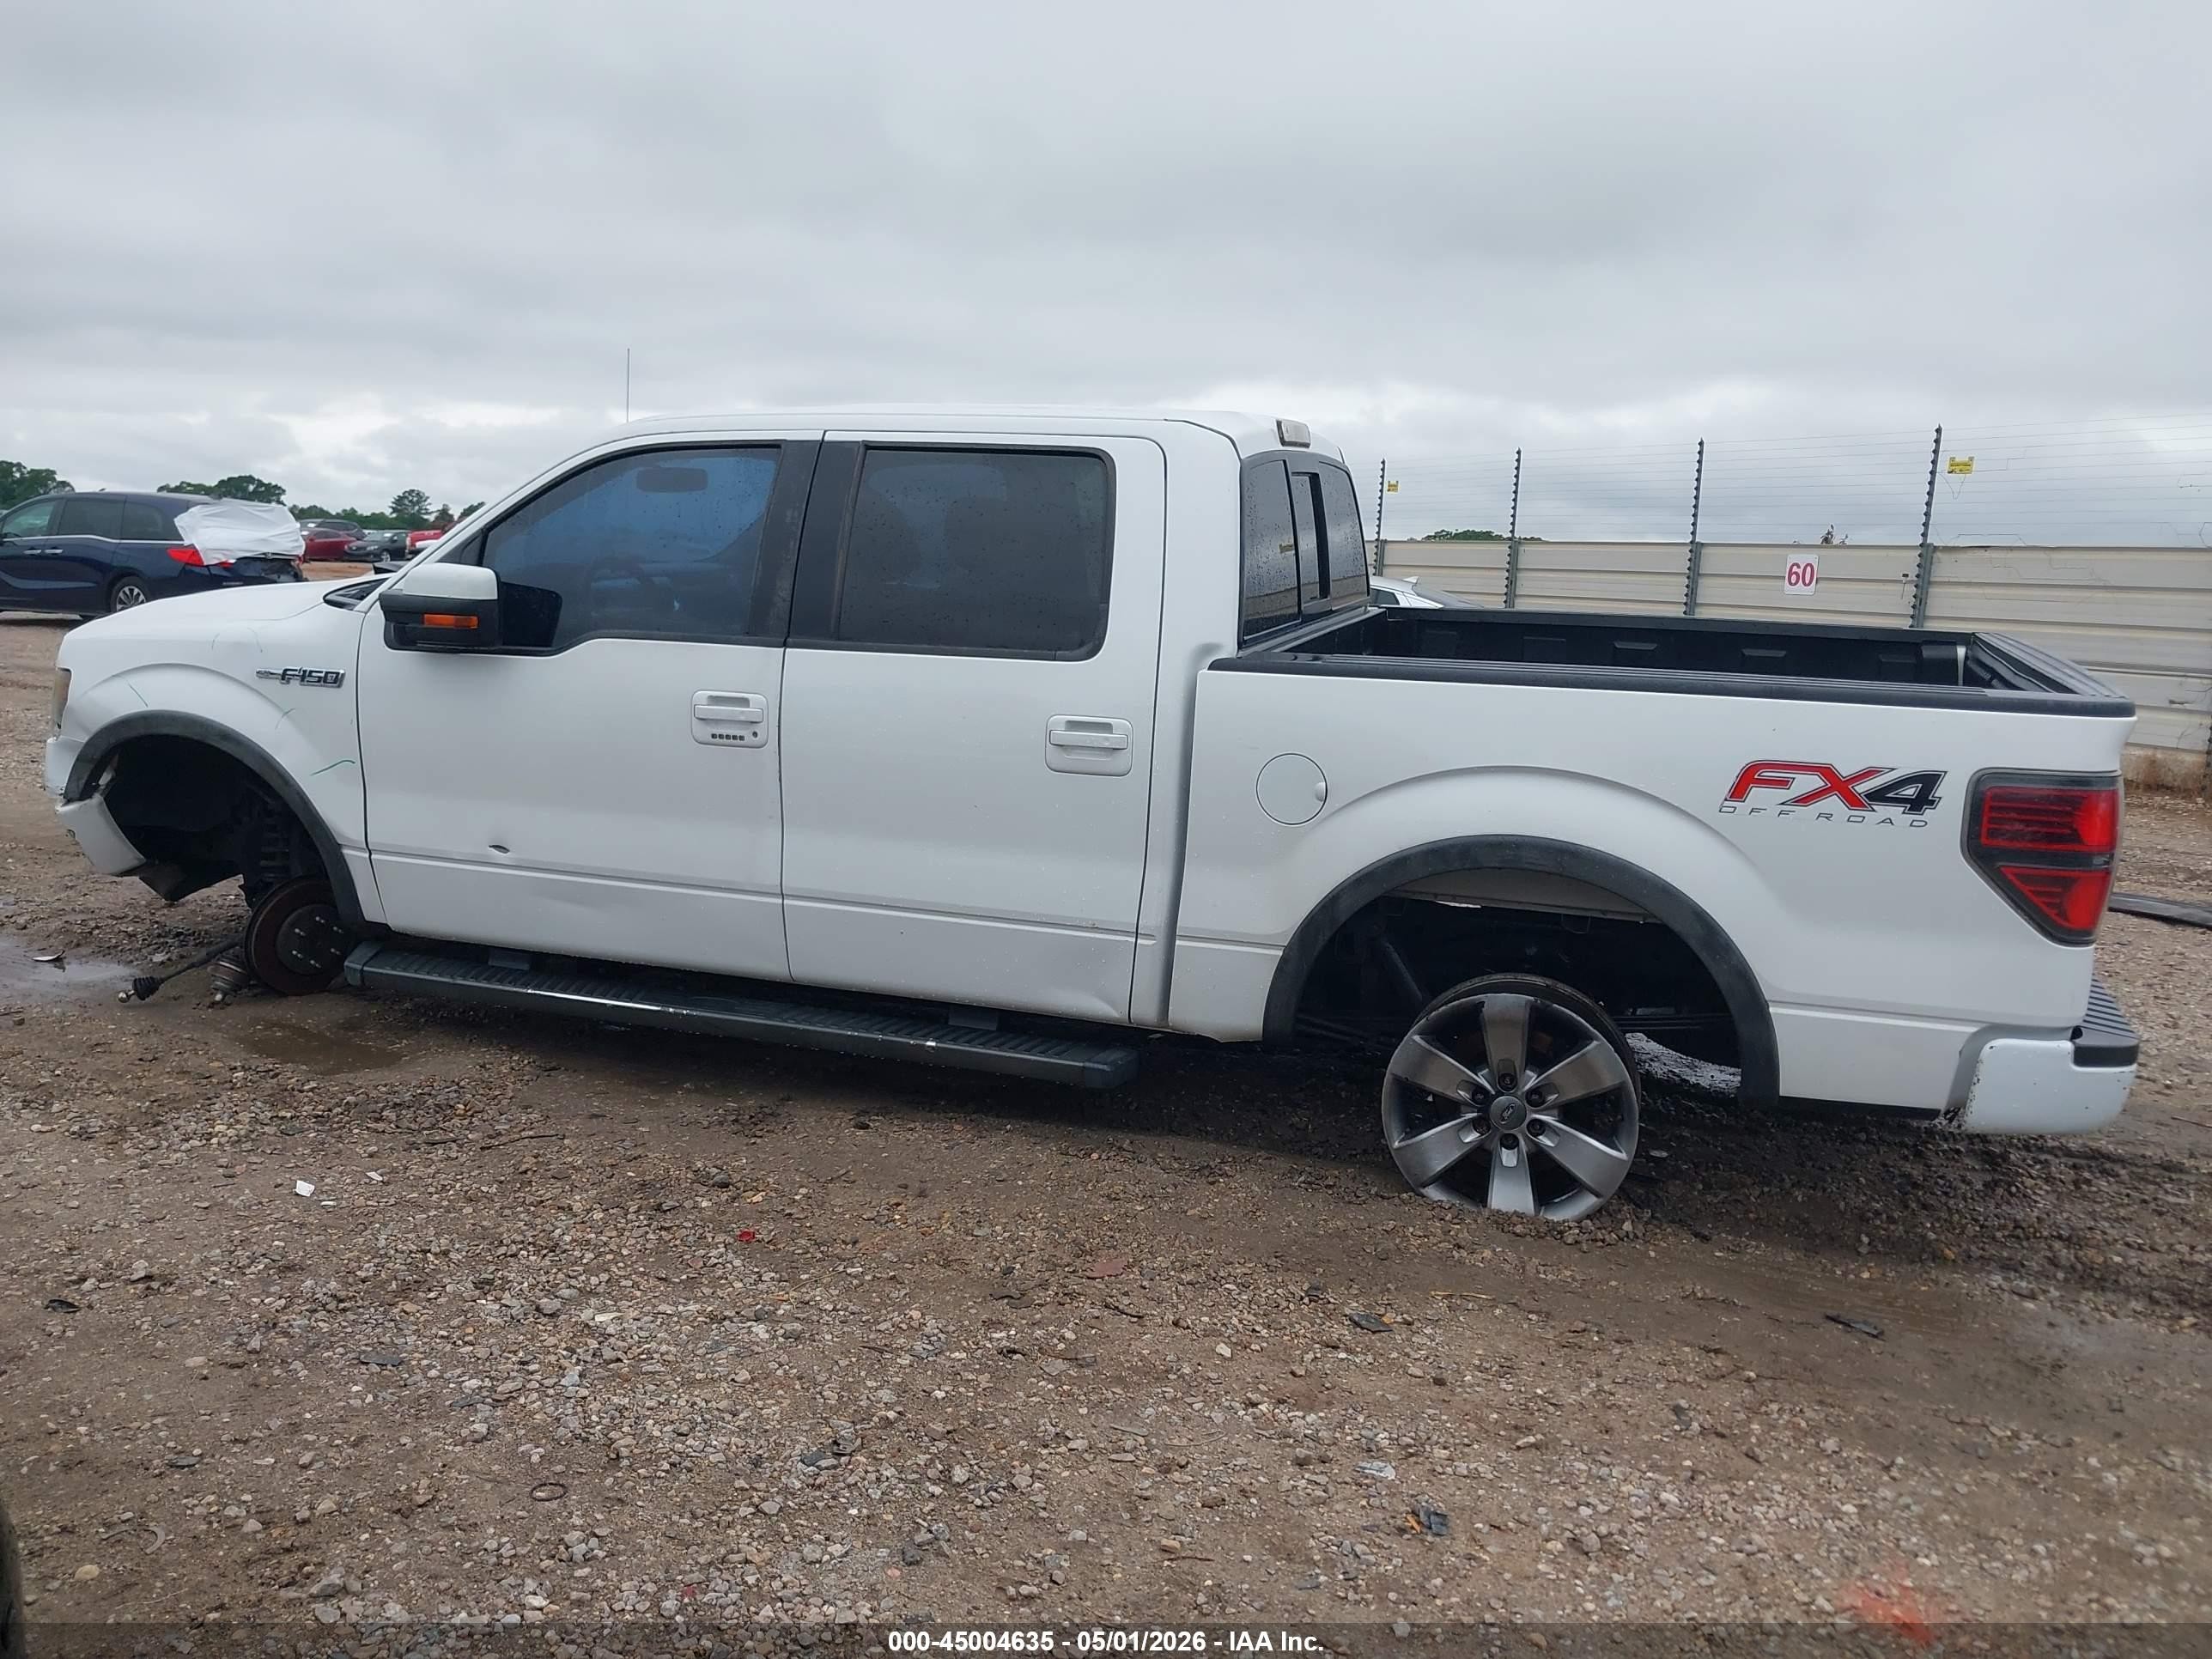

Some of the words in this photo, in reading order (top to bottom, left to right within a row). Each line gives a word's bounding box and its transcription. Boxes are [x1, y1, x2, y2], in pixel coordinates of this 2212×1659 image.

[1788, 562, 1815, 587] 60
[1723, 759, 1948, 816] FX4
[1718, 805, 1796, 818] OFF
[1815, 812, 1929, 828] ROAD
